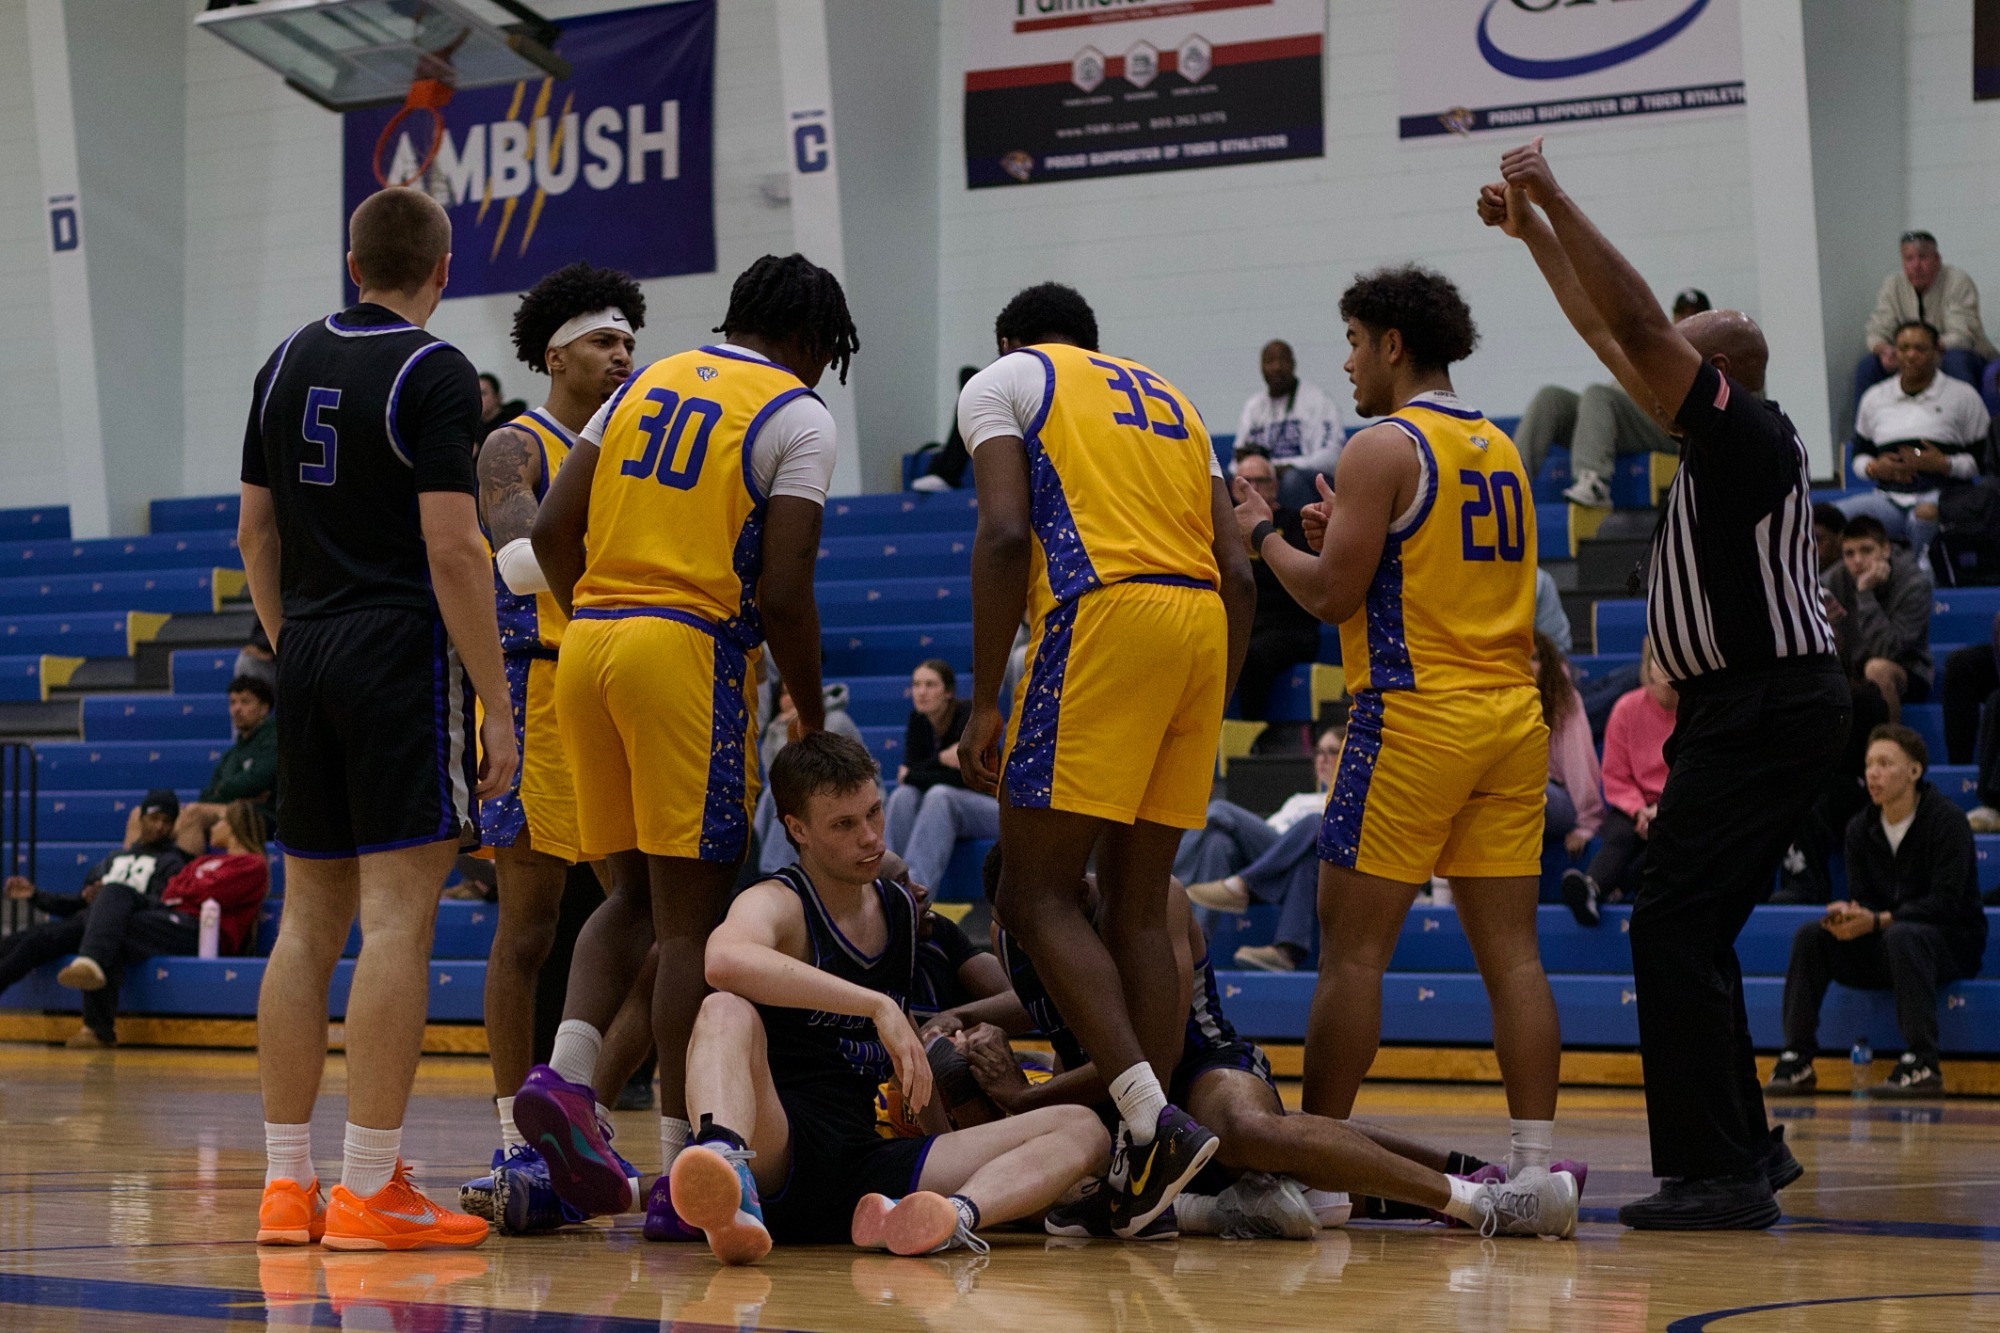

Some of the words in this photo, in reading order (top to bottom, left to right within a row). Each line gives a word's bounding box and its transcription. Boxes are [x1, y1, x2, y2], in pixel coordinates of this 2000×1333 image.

[794, 124, 828, 174] C
[1089, 146, 1160, 166] SUPPORTER
[1163, 144, 1179, 159] OF
[1182, 141, 1218, 157] TIGER
[1221, 134, 1288, 153] ATHLETICS
[1487, 107, 1535, 126] PROUD
[1536, 99, 1618, 121] SUPPORTER
[1620, 96, 1637, 112] OF
[1641, 91, 1682, 110] TIGER
[386, 100, 679, 206] AMBUSH
[51, 208, 78, 252] D
[299, 386, 342, 486] 5
[620, 387, 723, 491] 30
[1086, 356, 1189, 440] 35
[1459, 469, 1525, 562] 20
